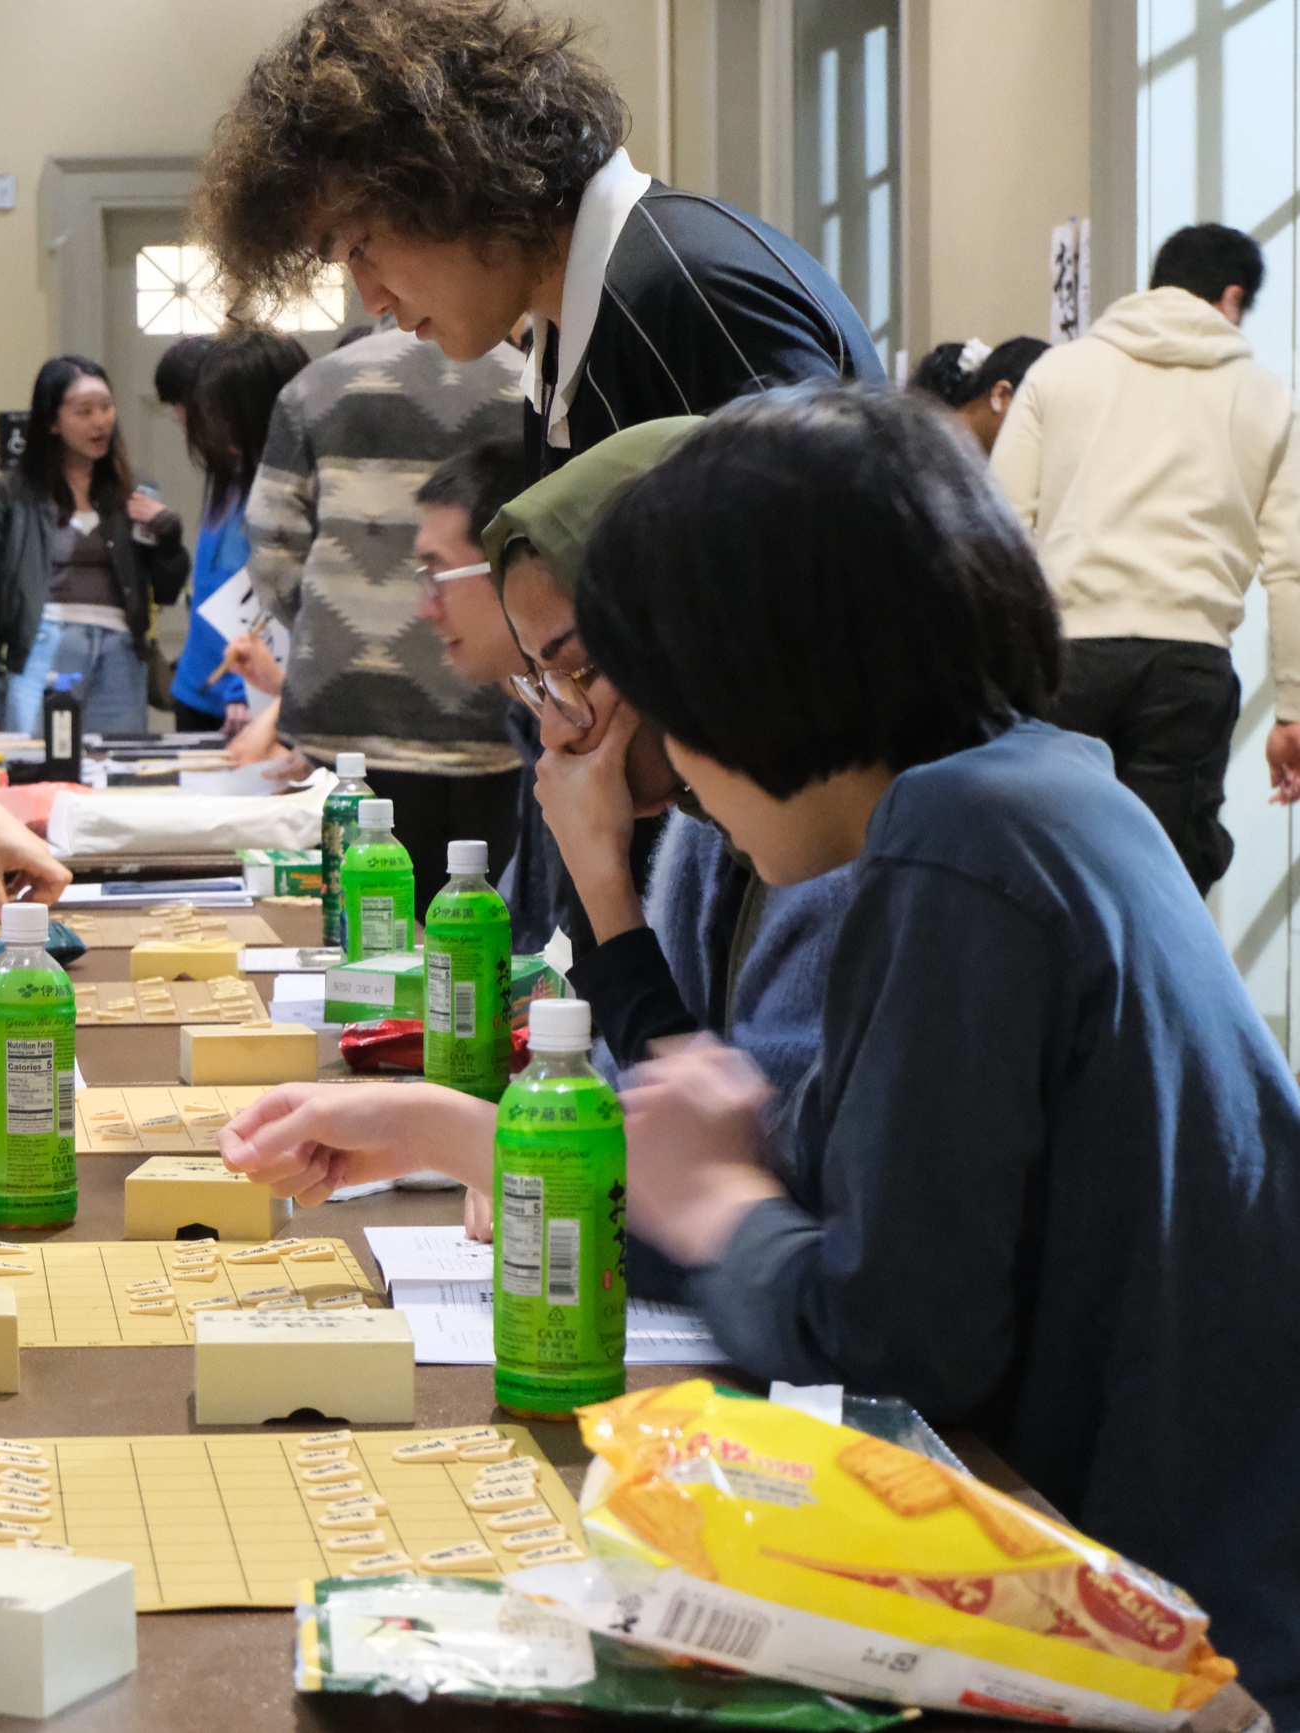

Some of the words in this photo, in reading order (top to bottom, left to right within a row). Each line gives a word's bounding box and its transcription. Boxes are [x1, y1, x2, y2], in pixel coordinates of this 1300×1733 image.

[356, 984, 370, 994] DEC
[5, 1017, 35, 1029] Green
[7, 1041, 36, 1049] Nutrition
[8, 1062, 42, 1071] Calories
[46, 1060, 52, 1070] 5
[533, 1203, 541, 1215] 5
[538, 1328, 552, 1339] CA
[556, 1329, 577, 1340] CRV
